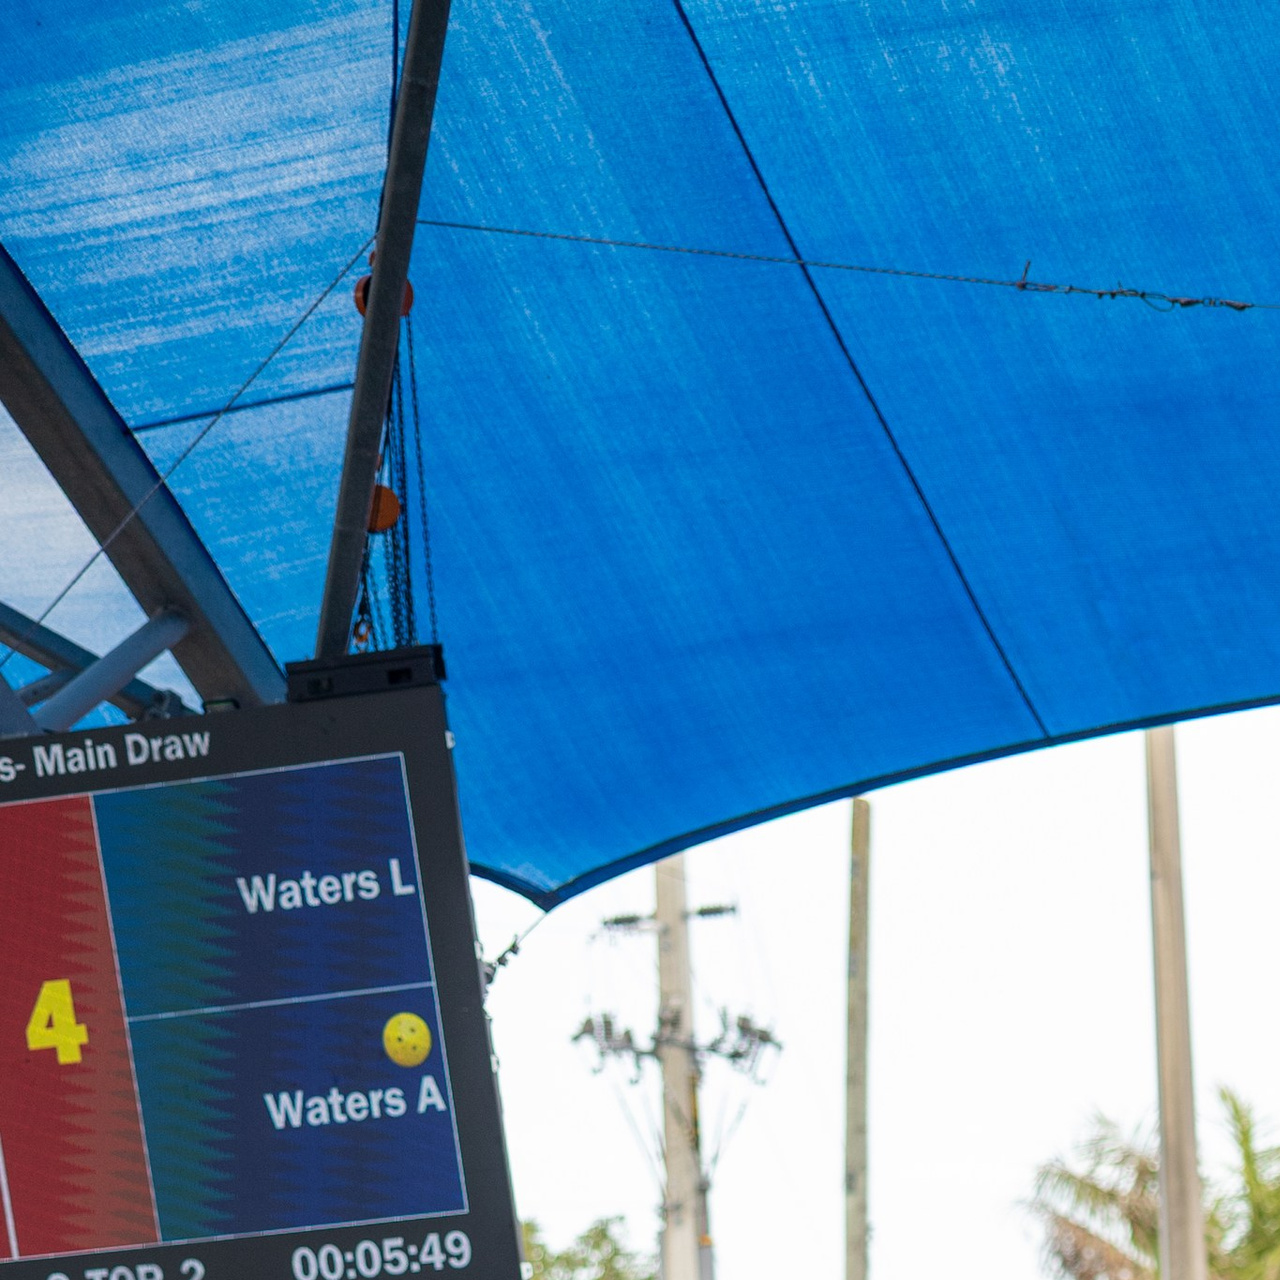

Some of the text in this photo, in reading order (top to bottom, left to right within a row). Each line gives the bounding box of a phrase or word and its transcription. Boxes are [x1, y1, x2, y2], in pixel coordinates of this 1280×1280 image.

[33, 738, 117, 778] Main
[125, 731, 210, 766] Draw
[237, 858, 416, 914] Waters L
[26, 979, 89, 1065] 4
[264, 1075, 447, 1130] Waters A
